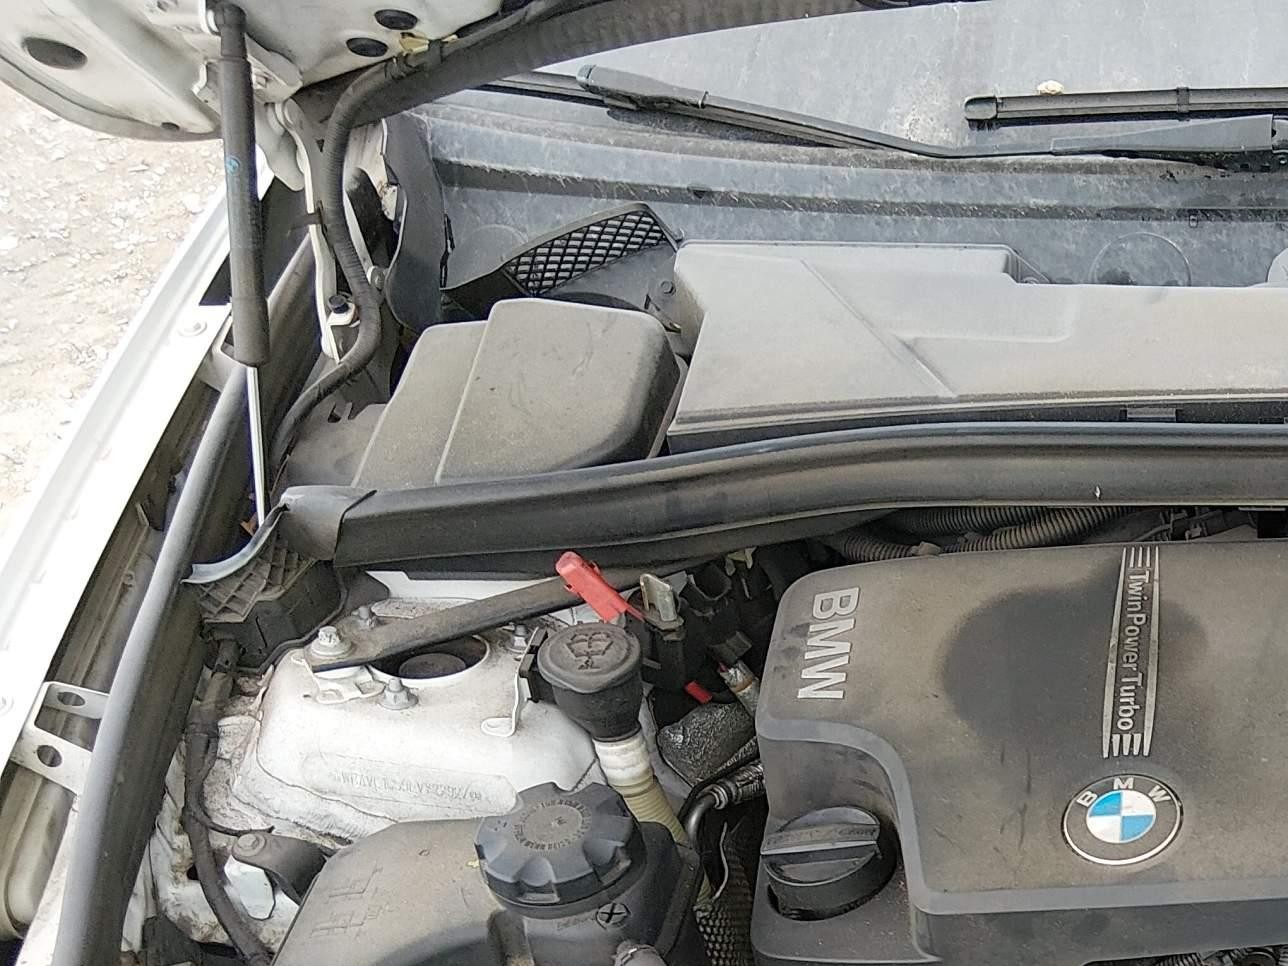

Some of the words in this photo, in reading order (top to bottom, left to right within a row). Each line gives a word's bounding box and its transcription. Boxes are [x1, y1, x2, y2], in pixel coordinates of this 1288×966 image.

[797, 587, 861, 700] BMW
[1121, 569, 1151, 671] TwinPower
[1116, 672, 1143, 731] Turbo
[1076, 776, 1173, 808] BMW
